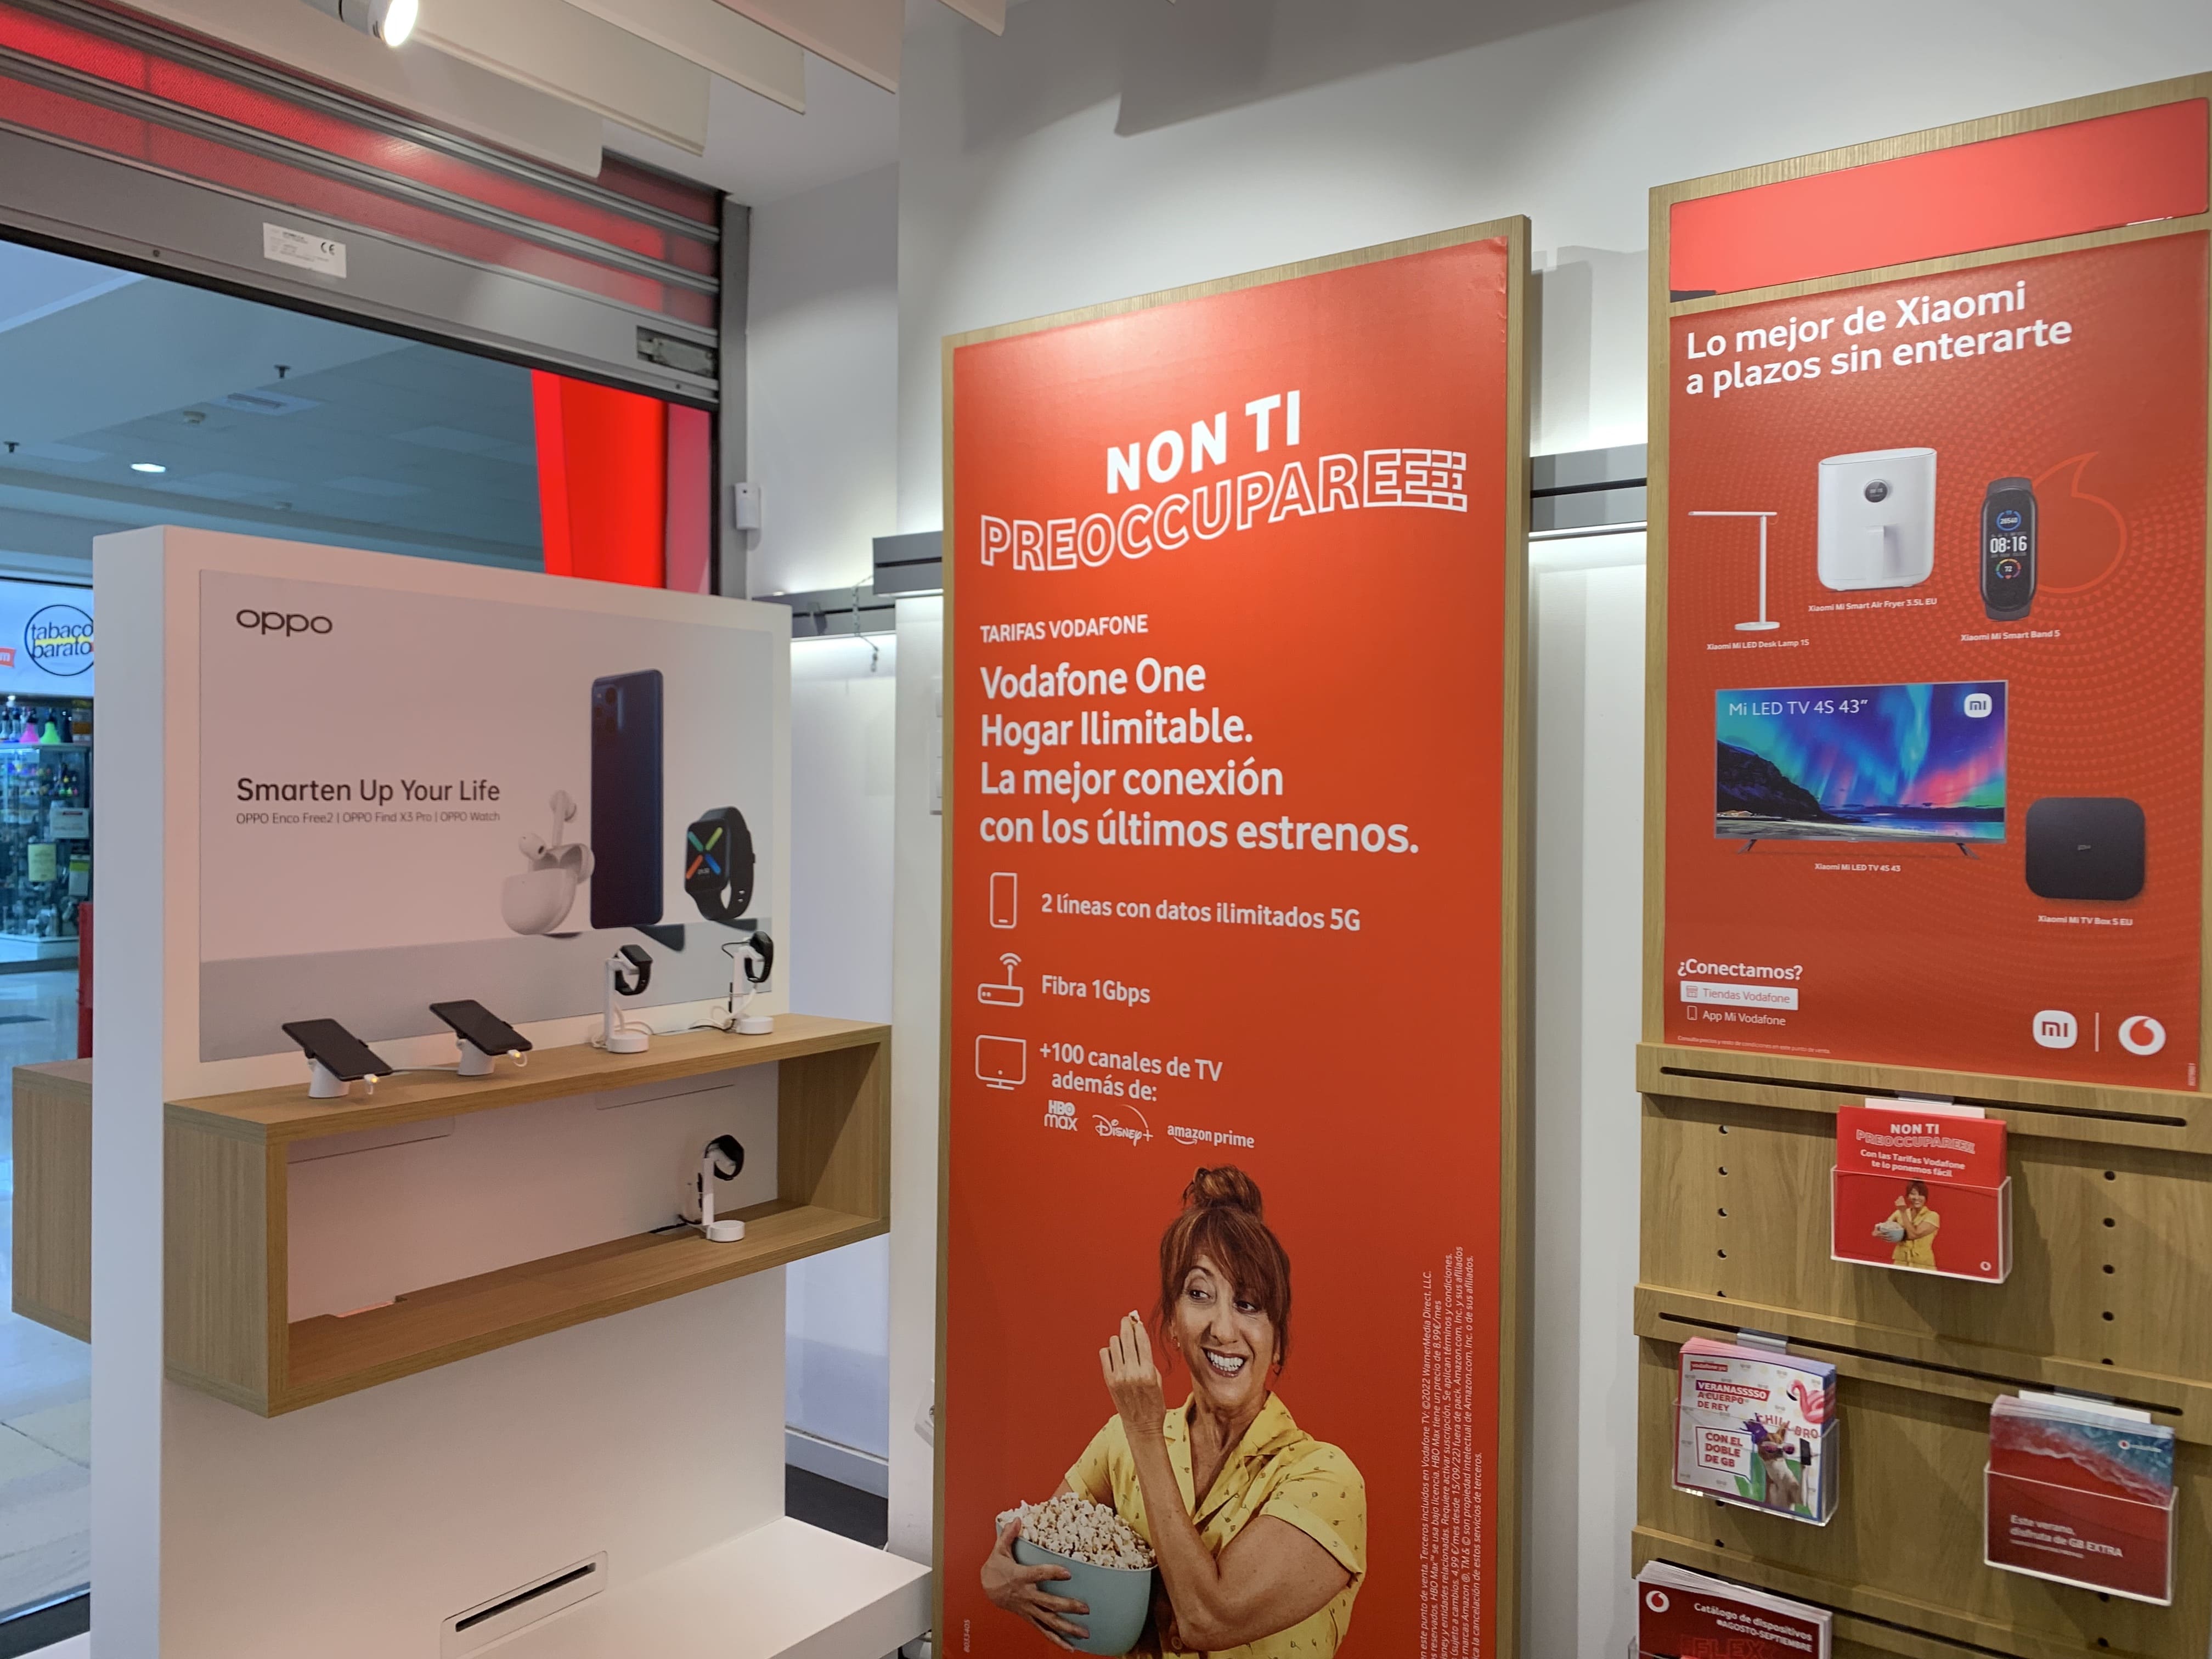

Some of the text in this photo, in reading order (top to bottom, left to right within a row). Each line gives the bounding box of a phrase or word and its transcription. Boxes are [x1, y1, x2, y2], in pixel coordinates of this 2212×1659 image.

[1688, 280, 2025, 359] Lo mejor de Xiaomi
[1686, 319, 2073, 398] a plazos sin enterarte
[1107, 390, 1301, 494] NON TI
[1990, 536, 2027, 553] 08:16
[1846, 602, 1870, 610] Smart
[1884, 600, 1905, 609] Fryer
[31, 622, 93, 640] tabaco
[236, 610, 332, 636] oppo
[980, 614, 1148, 643] TARIFAS VODAFONE
[32, 639, 92, 658] barato
[980, 658, 1206, 699] Vodafone One
[1729, 703, 1747, 715] Mi
[1752, 702, 1783, 715] LED
[1786, 701, 1810, 714] TV
[1814, 700, 1834, 714] 4S
[981, 707, 1253, 755] Hogar Ilimitable.
[981, 756, 1283, 803] La mejor conexión
[238, 778, 500, 805] Smarten Up Your Life
[236, 811, 500, 824] OPPO Enco Free2 OPPO Find X3 Pro OPPO Watch
[980, 808, 1419, 854] con los últimos estrenos.
[1041, 894, 1361, 932] 2 líneas con datos ilimitados 5G
[1677, 958, 1803, 980] ¿Conectamos?
[1042, 975, 1150, 1007] Fibra 1Gbps
[1703, 988, 1790, 1003] Tiendas Vodafone
[1702, 1010, 1786, 1026] App Mi Vodafone
[1040, 1042, 1223, 1082] +100 canales de TV
[1052, 1071, 1157, 1102] además de:
[1048, 1099, 1075, 1116] HBO
[1044, 1113, 1078, 1131] max
[1891, 1124, 1939, 1134] NON TI
[1167, 1125, 1255, 1148] amazon prime
[1860, 1149, 1965, 1170] Con las Tarifas Vodafone
[1892, 1164, 1932, 1175] ponemos
[1422, 1321, 1431, 1376] WarnerMedia
[1422, 1379, 1430, 1409] ©2022
[1697, 1382, 1767, 1399] VERANASSSSO
[1706, 1392, 1743, 1404] CUERPO
[1697, 1401, 1730, 1412] DE REY
[1705, 1432, 1743, 1447] CON EL
[1795, 1426, 1819, 1439] BRO
[1421, 1426, 1430, 1467] Vodafone
[1705, 1443, 1740, 1457] DOBLE
[1705, 1454, 1735, 1468] DE GB
[1423, 1470, 1429, 1481] en
[1420, 1483, 1429, 1521] incluidos
[1420, 1523, 1429, 1559] Terceros
[2069, 1537, 2084, 1549] GB
[2086, 1542, 2123, 1558] EXTRA
[1420, 1592, 1428, 1601] de
[1420, 1604, 1430, 1629] punto
[1694, 1602, 1812, 1641] Catálogo de dispositivos
[1420, 1631, 1428, 1649] este
